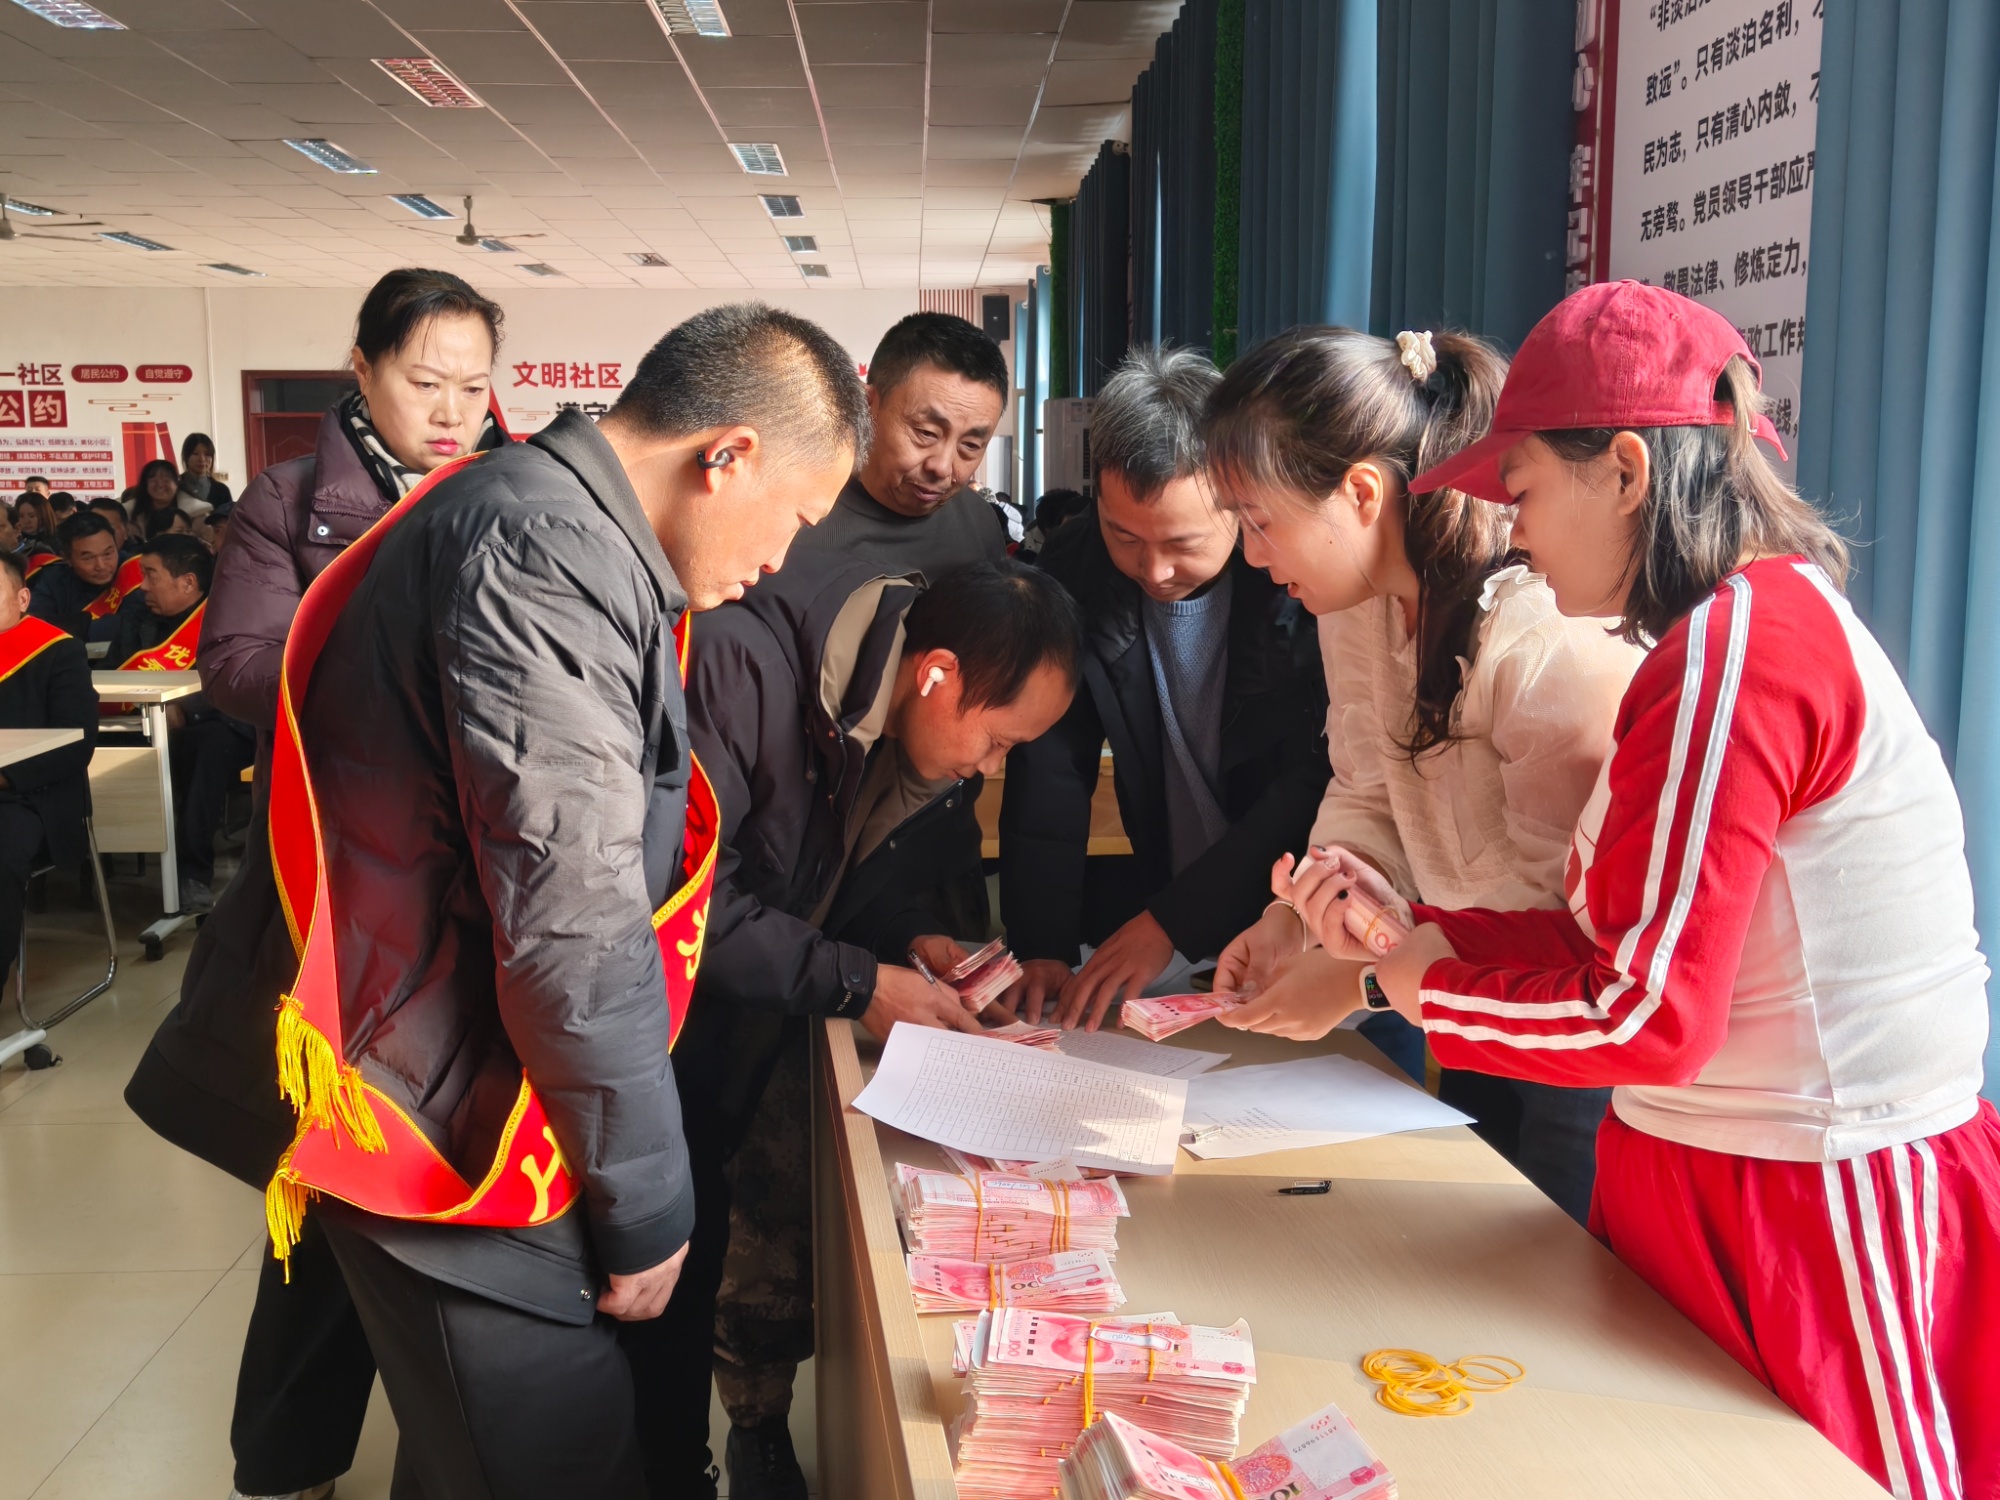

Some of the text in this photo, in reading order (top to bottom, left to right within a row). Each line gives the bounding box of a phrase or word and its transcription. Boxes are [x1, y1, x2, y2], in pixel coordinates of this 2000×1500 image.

[0, 363, 64, 386] 一社区
[81, 368, 120, 379] 居民公约
[145, 368, 184, 379] 自觉遵守
[512, 361, 623, 389] 文明社区
[0, 395, 62, 424] 公约
